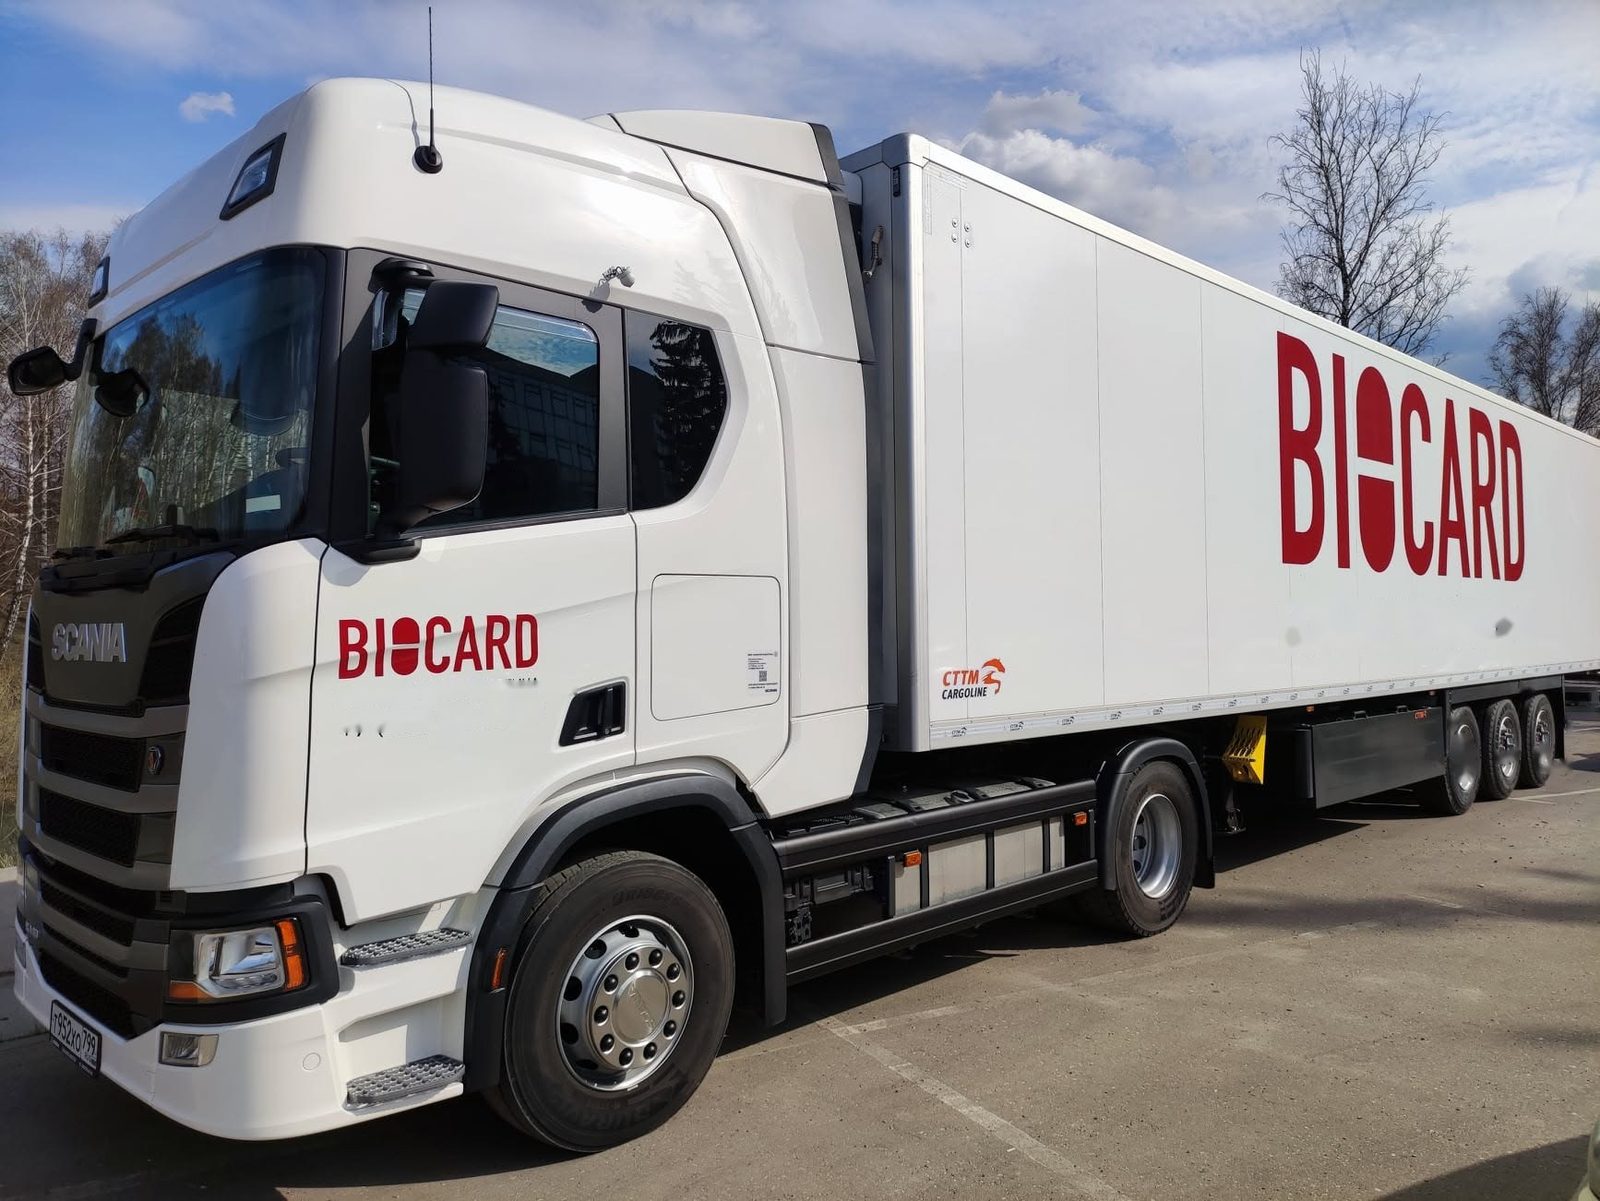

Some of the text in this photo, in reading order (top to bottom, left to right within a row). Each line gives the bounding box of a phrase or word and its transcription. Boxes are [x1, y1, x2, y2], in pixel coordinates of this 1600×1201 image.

[1277, 330, 1525, 582] BIOCARD
[51, 622, 127, 663] SCANIA
[338, 613, 539, 680] BIOCARD
[942, 669, 980, 687] CTTM
[942, 686, 988, 700] CARGOLINE
